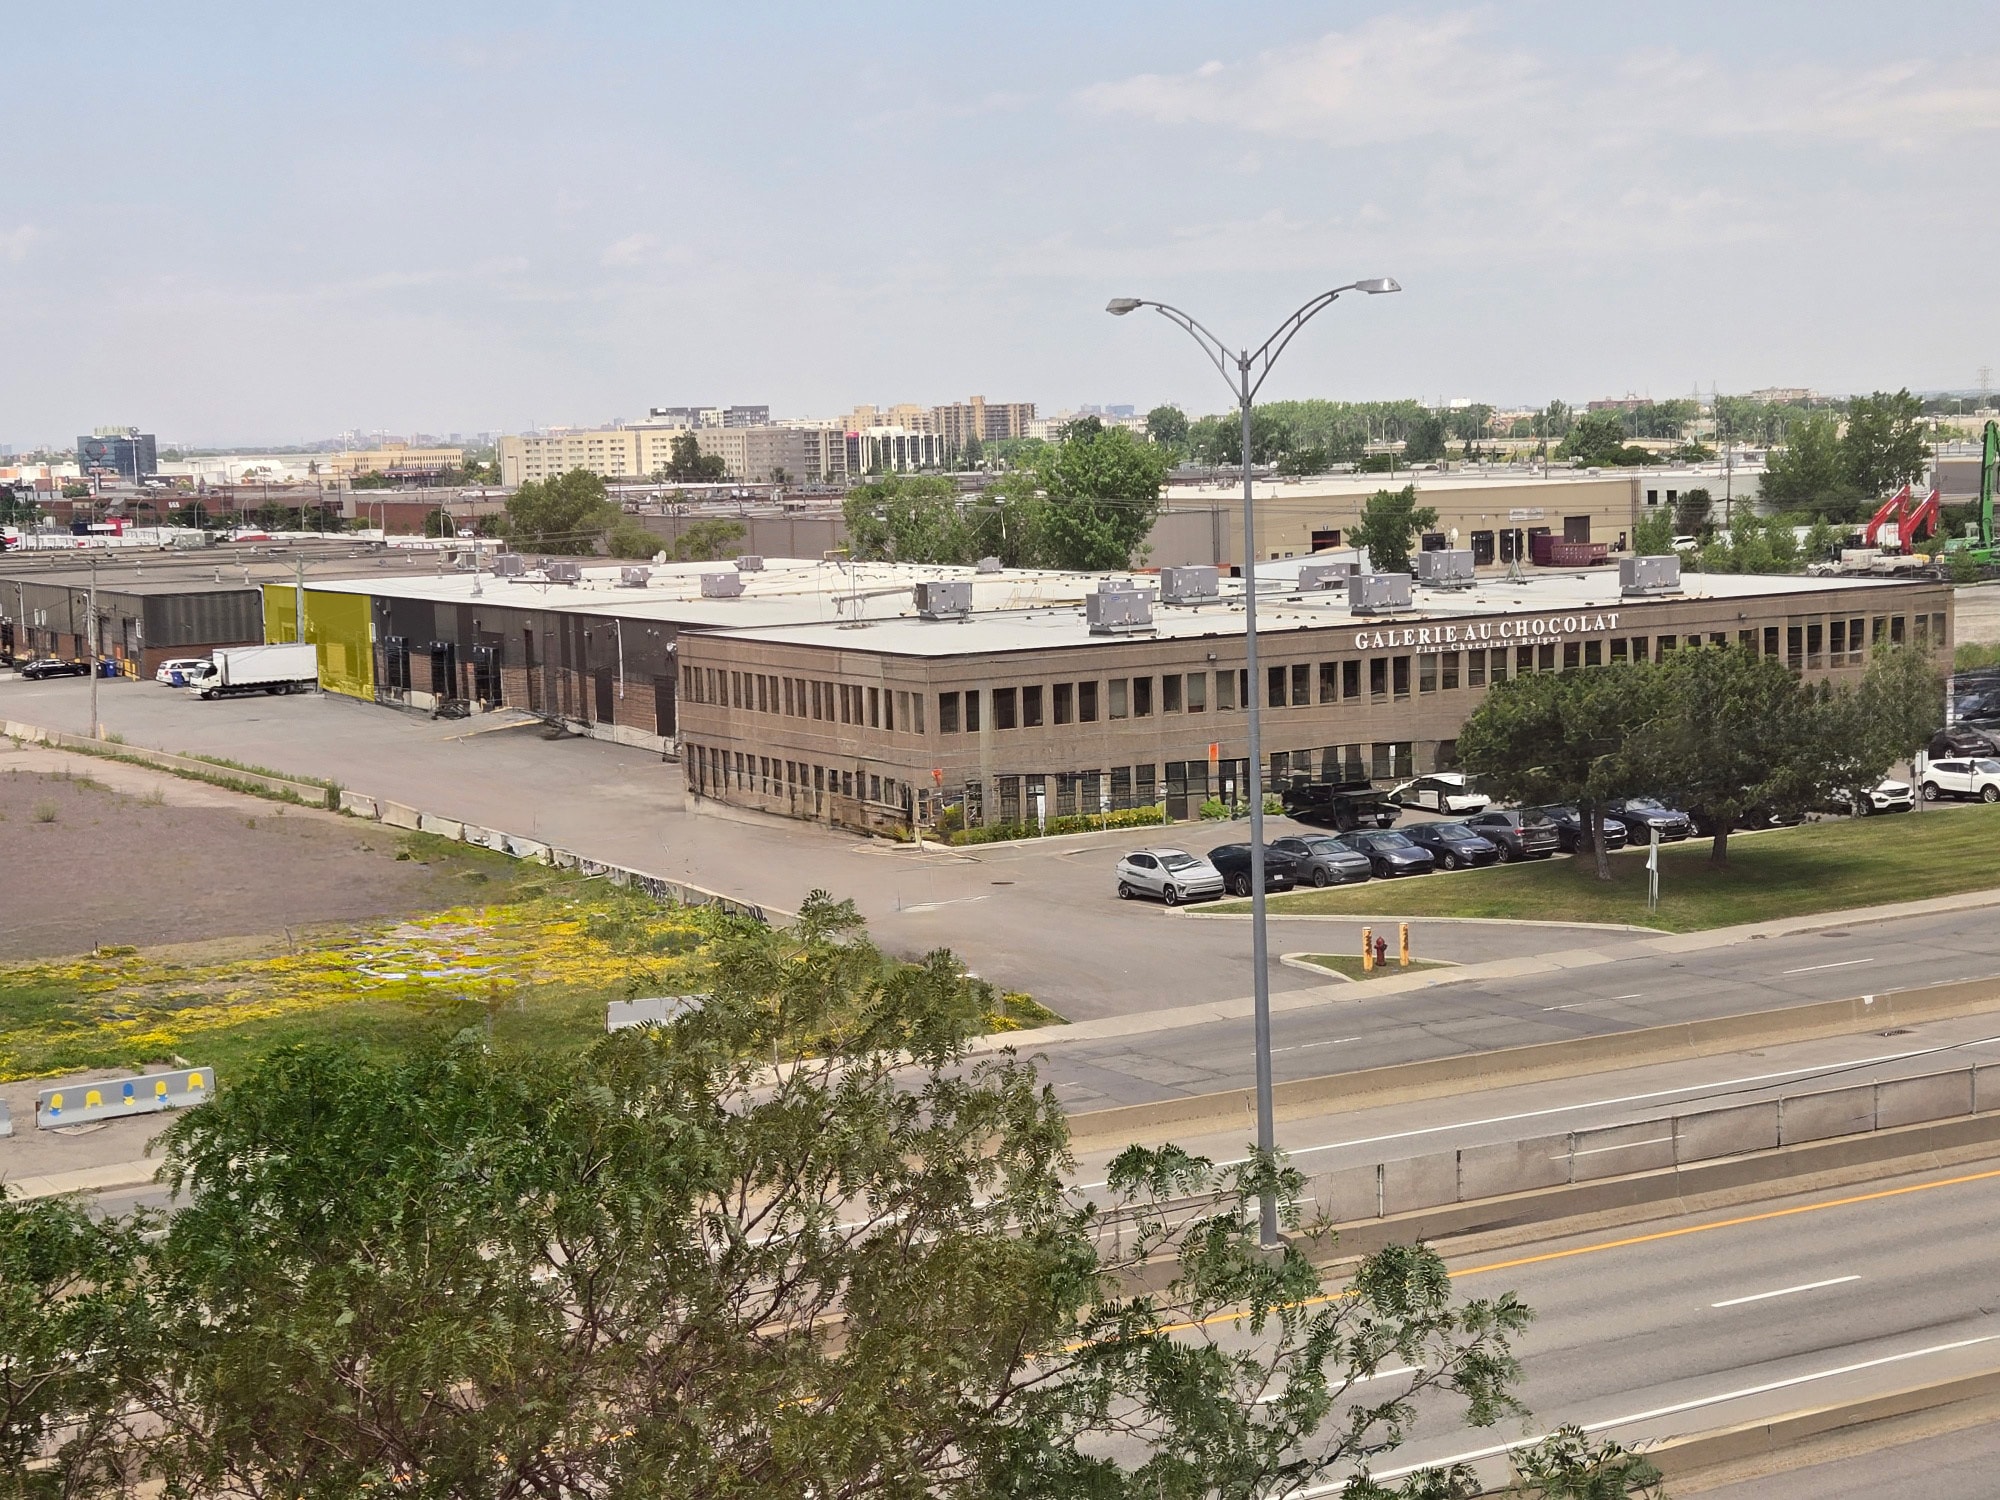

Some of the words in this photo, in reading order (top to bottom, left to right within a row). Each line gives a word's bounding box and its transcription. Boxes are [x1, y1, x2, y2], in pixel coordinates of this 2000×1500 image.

[1355, 626, 1457, 650] GALERIE
[1464, 623, 1492, 641] AU
[1500, 613, 1619, 638] CHOCOLAT
[1416, 644, 1443, 654] Fins
[1451, 639, 1514, 651] Chocolats
[1522, 635, 1562, 646] Belges
